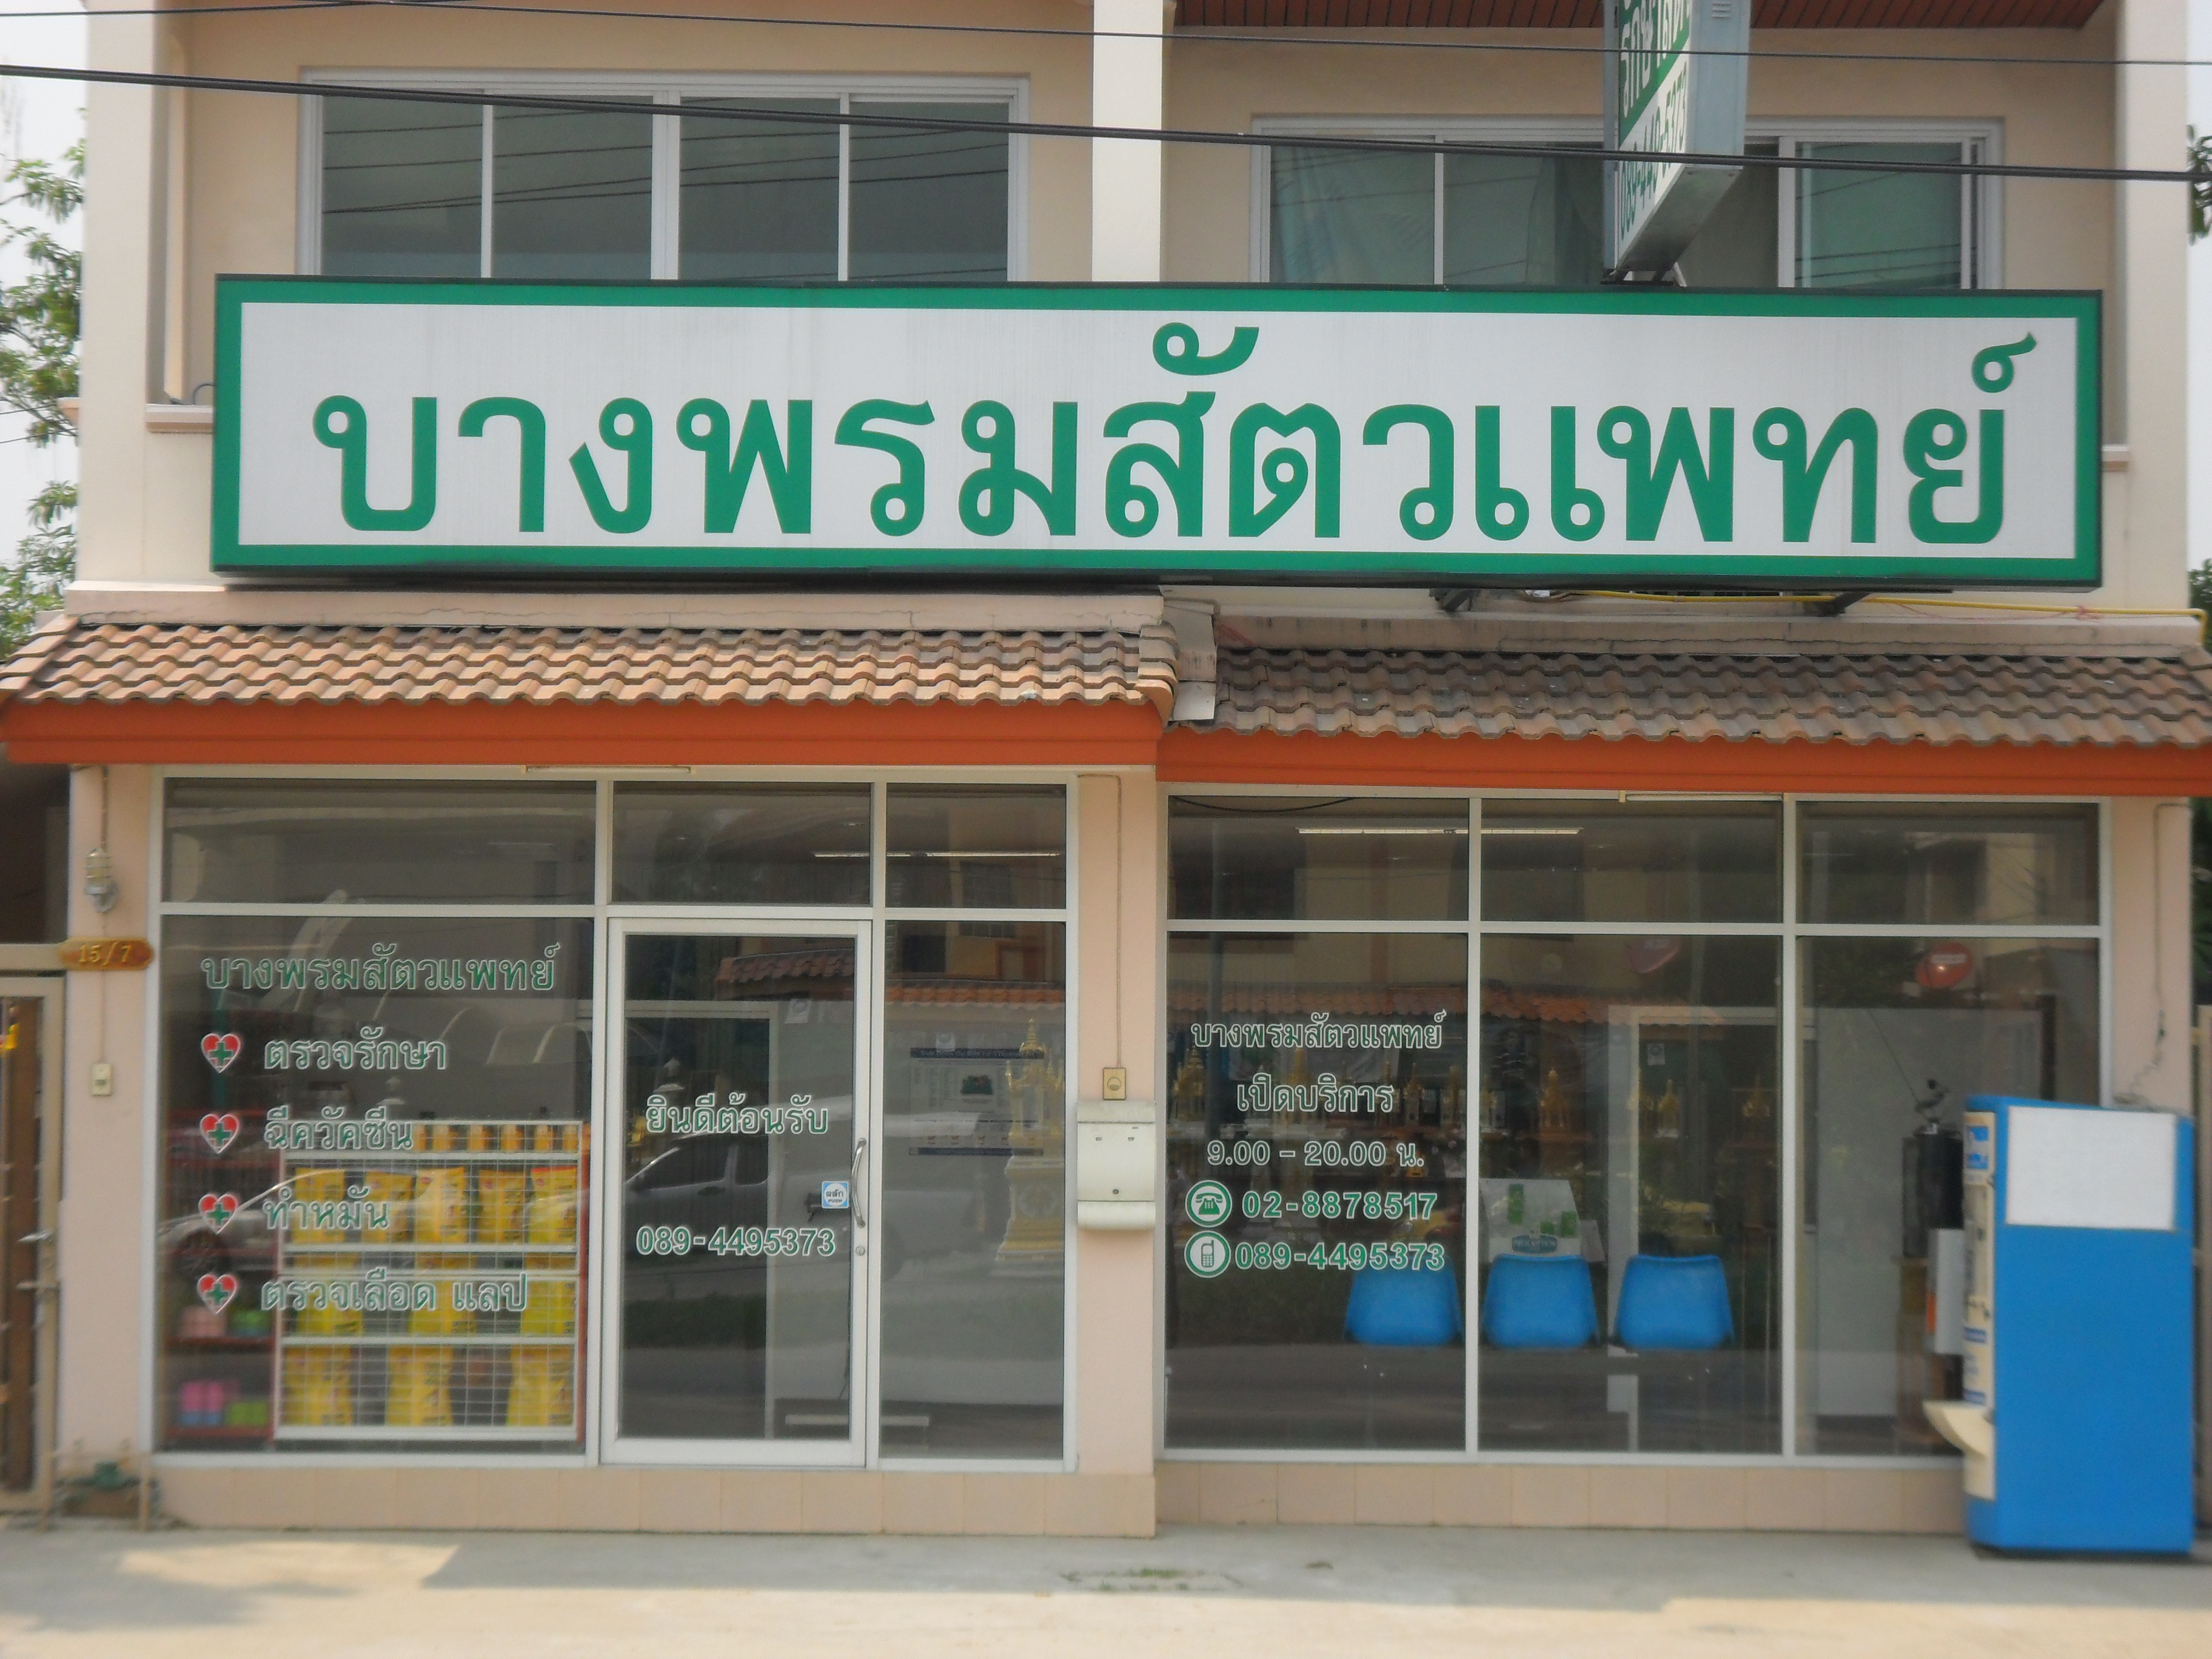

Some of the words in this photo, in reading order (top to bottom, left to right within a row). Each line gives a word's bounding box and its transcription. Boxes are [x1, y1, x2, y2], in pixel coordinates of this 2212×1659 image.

[315, 324, 2036, 544] บางพรมสัตวแพทย์
[79, 942, 132, 965] 15/7
[201, 943, 560, 991] บางพรมสัตวแพทย์
[264, 1026, 446, 1070] ตรวจรักษา
[1191, 1008, 1447, 1049] บางพรมสัตวแพทย์
[646, 1092, 828, 1134] ยินดีต้อนรับ
[1237, 1072, 1394, 1113] เปิดบริการ
[1207, 1140, 1270, 1166] 9.00
[1304, 1141, 1386, 1167] 20.00
[1396, 1142, 1425, 1167] น.
[263, 1185, 389, 1230] ทำหมัน
[1242, 1191, 1438, 1220] 02-8878517
[636, 1225, 836, 1256] 089-4495373
[1235, 1242, 1445, 1271] 089-4495373
[261, 1267, 436, 1311] ตรวจเลือด
[452, 1272, 528, 1312] แลป
